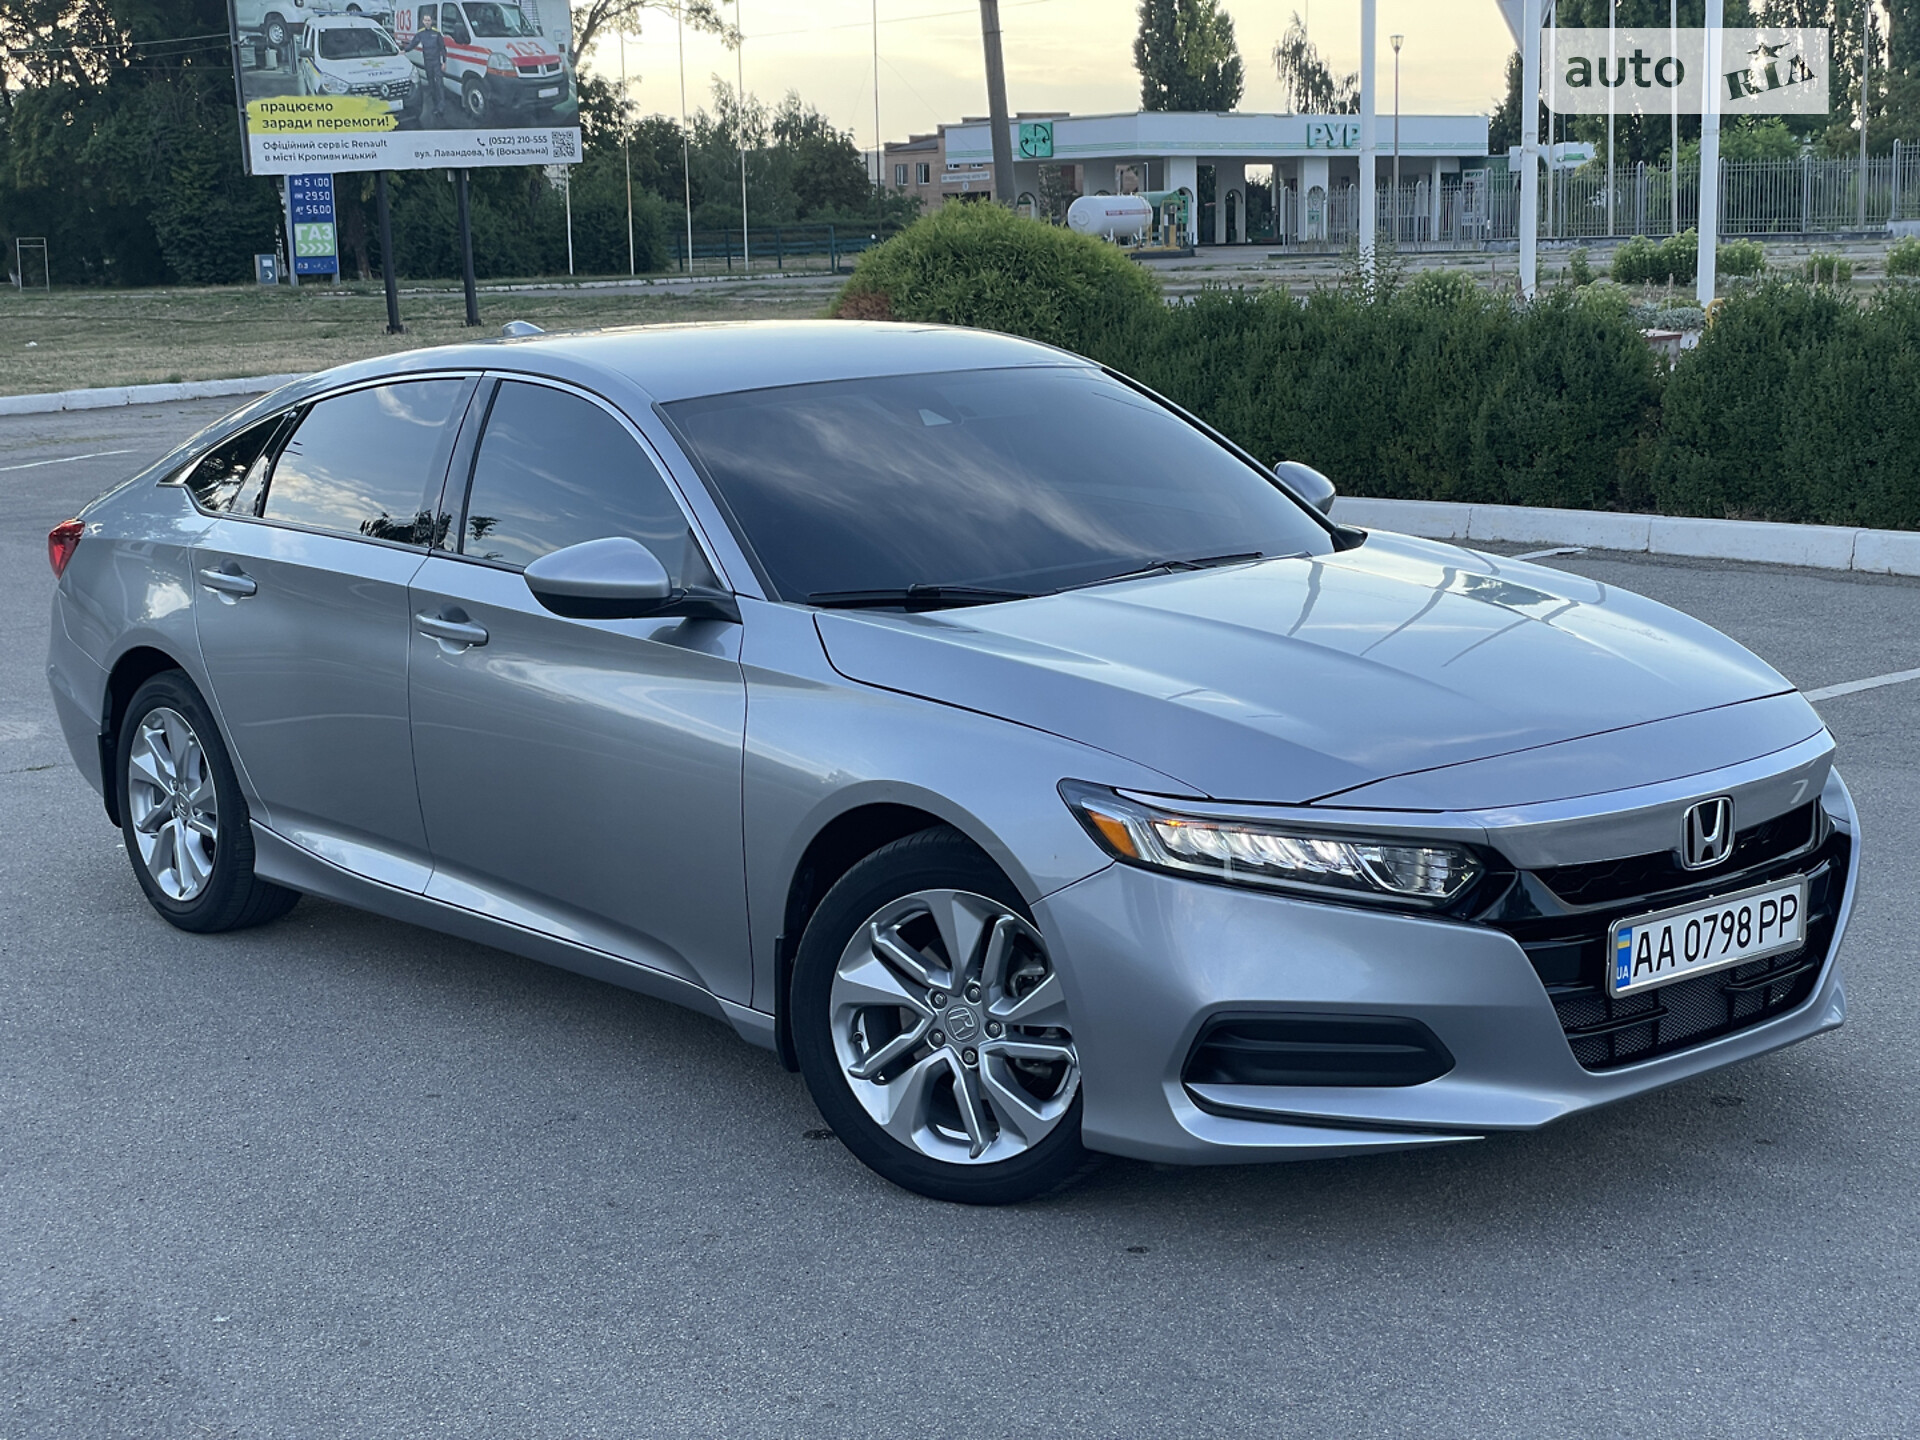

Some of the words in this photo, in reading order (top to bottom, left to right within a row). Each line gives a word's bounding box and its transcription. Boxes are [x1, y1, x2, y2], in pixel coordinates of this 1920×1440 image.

[506, 41, 546, 57] 103
[260, 102, 333, 114] працюємо
[262, 118, 313, 130] заради
[317, 116, 389, 130] перемоги!
[263, 141, 316, 151] Офіційний
[317, 140, 350, 150] сервіс
[351, 139, 388, 148] Renault
[489, 136, 515, 145] (0522)
[518, 135, 547, 144] 210-555
[272, 153, 297, 162] місті
[296, 225, 333, 241] ГАЗ
[1633, 925, 1675, 977] AA
[1684, 905, 1752, 962] 0798
[1758, 894, 1798, 944] PP
[1616, 966, 1629, 979] UA
